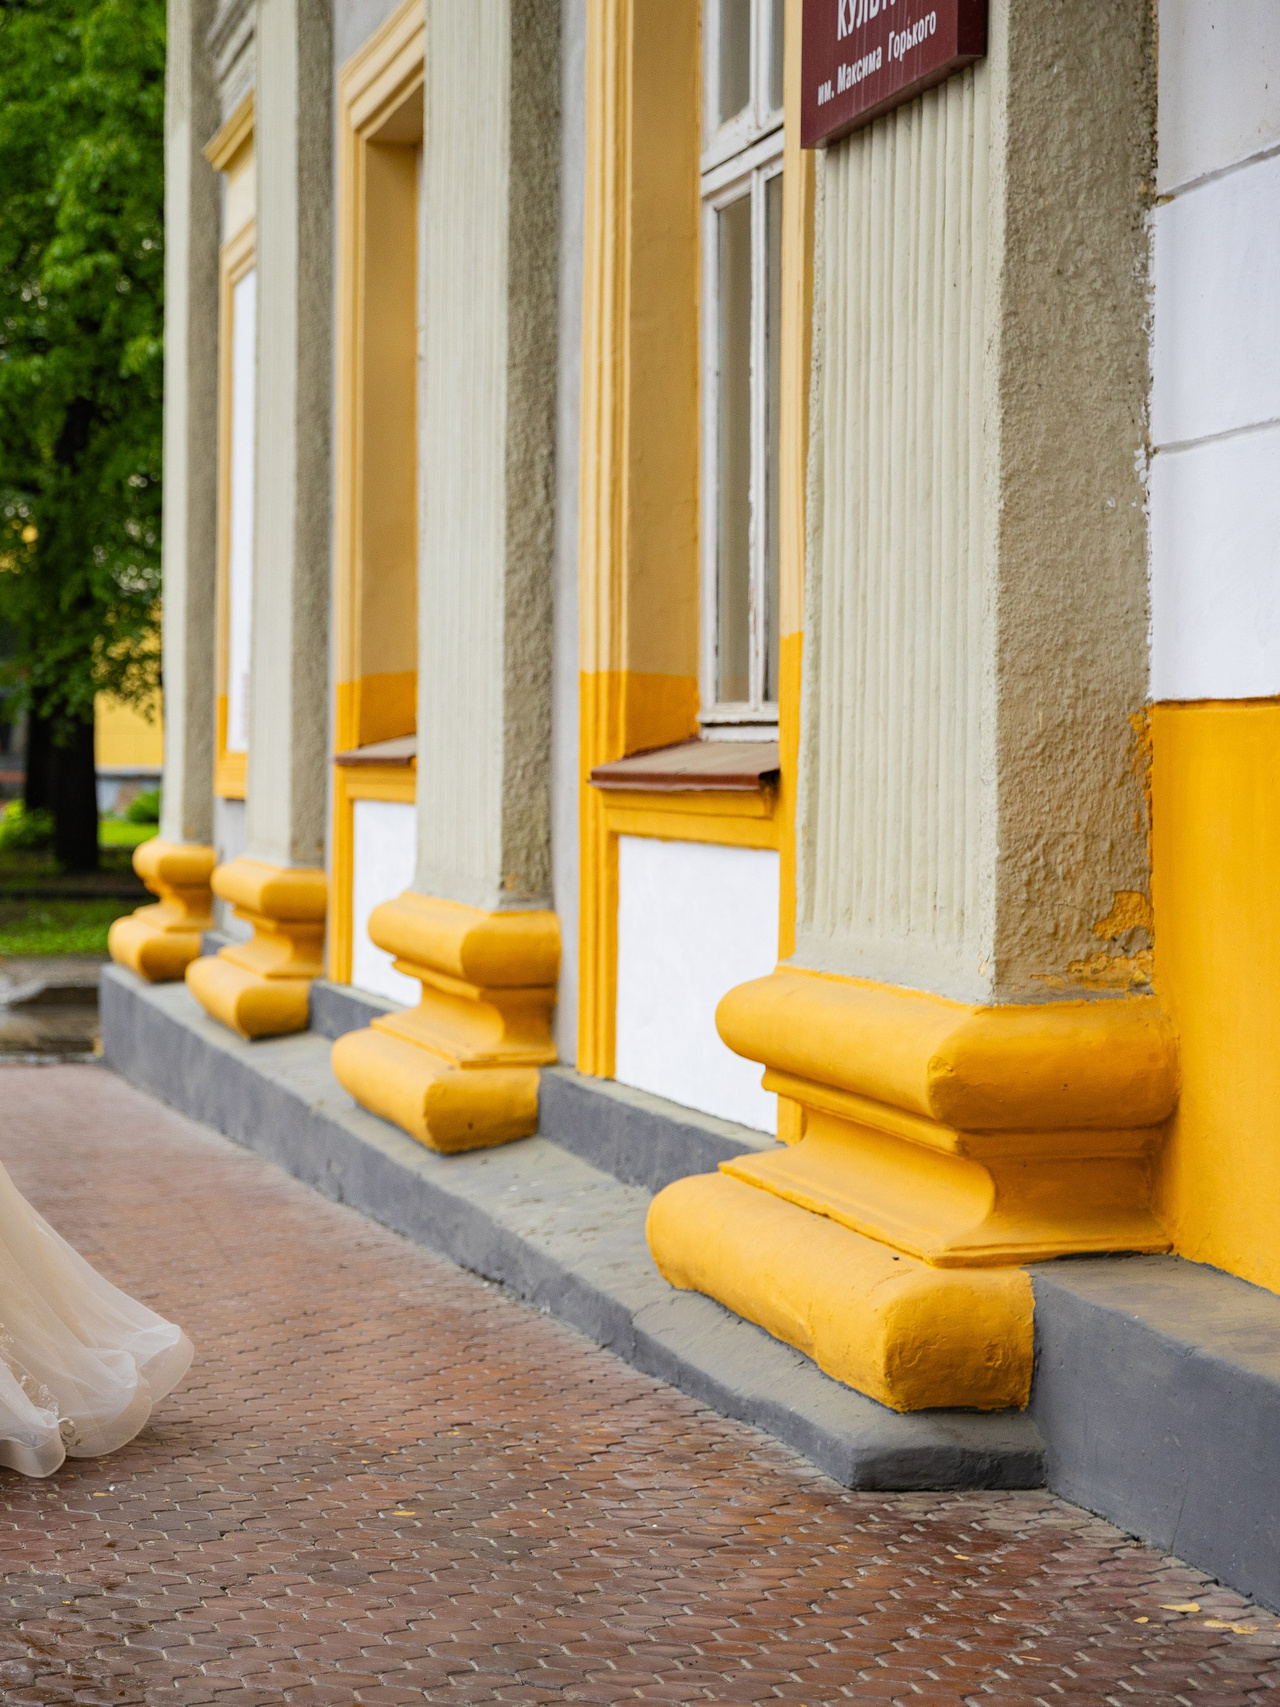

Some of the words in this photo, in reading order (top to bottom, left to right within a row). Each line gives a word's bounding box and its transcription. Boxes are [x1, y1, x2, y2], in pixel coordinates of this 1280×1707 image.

[818, 80, 835, 106] им.
[837, 46, 882, 95] Максима
[888, 10, 937, 62] Горького
